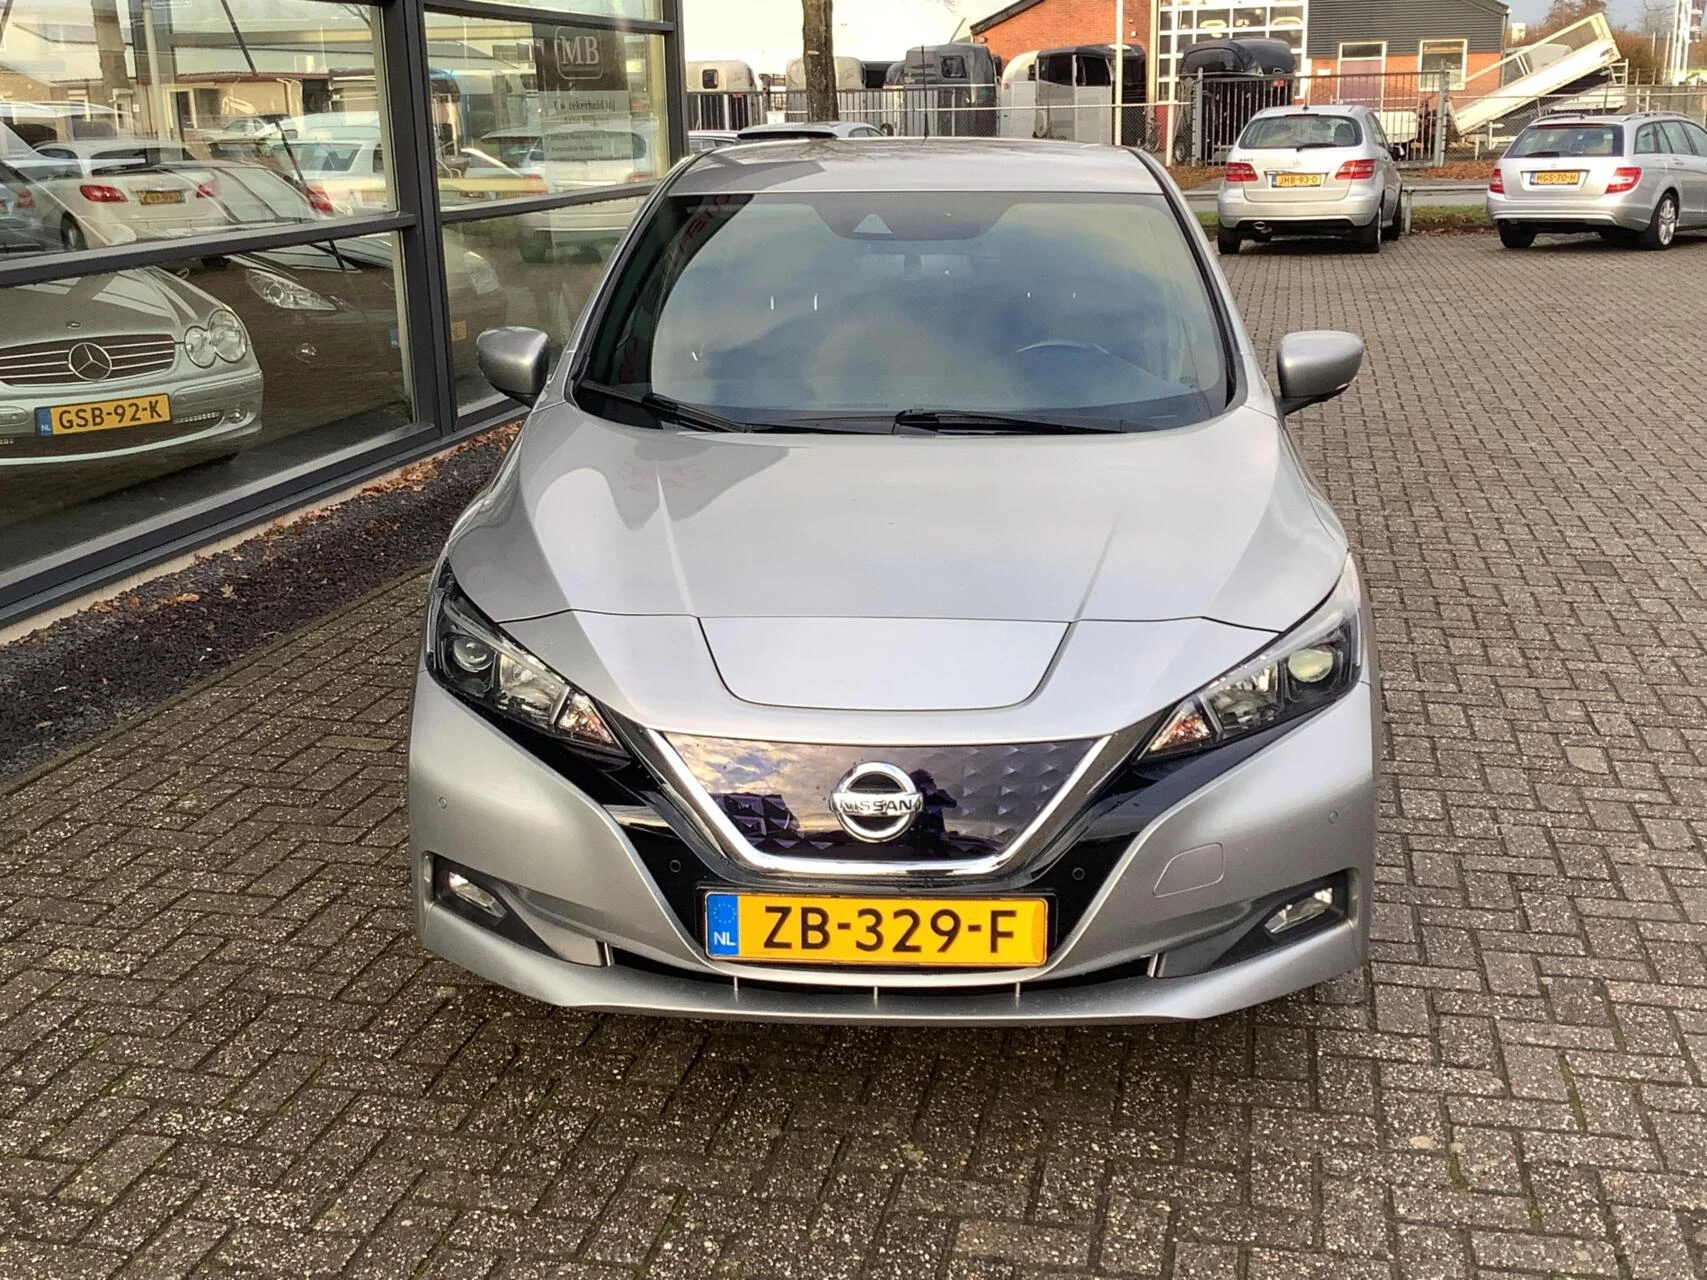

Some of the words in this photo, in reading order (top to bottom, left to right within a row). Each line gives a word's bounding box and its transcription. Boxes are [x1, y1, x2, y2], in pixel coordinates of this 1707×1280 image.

[559, 35, 600, 65] MB
[58, 400, 163, 430] GSB-92-K
[840, 799, 912, 812] NISSAN
[714, 931, 736, 946] NL
[763, 905, 1017, 953] ZB-329-F
